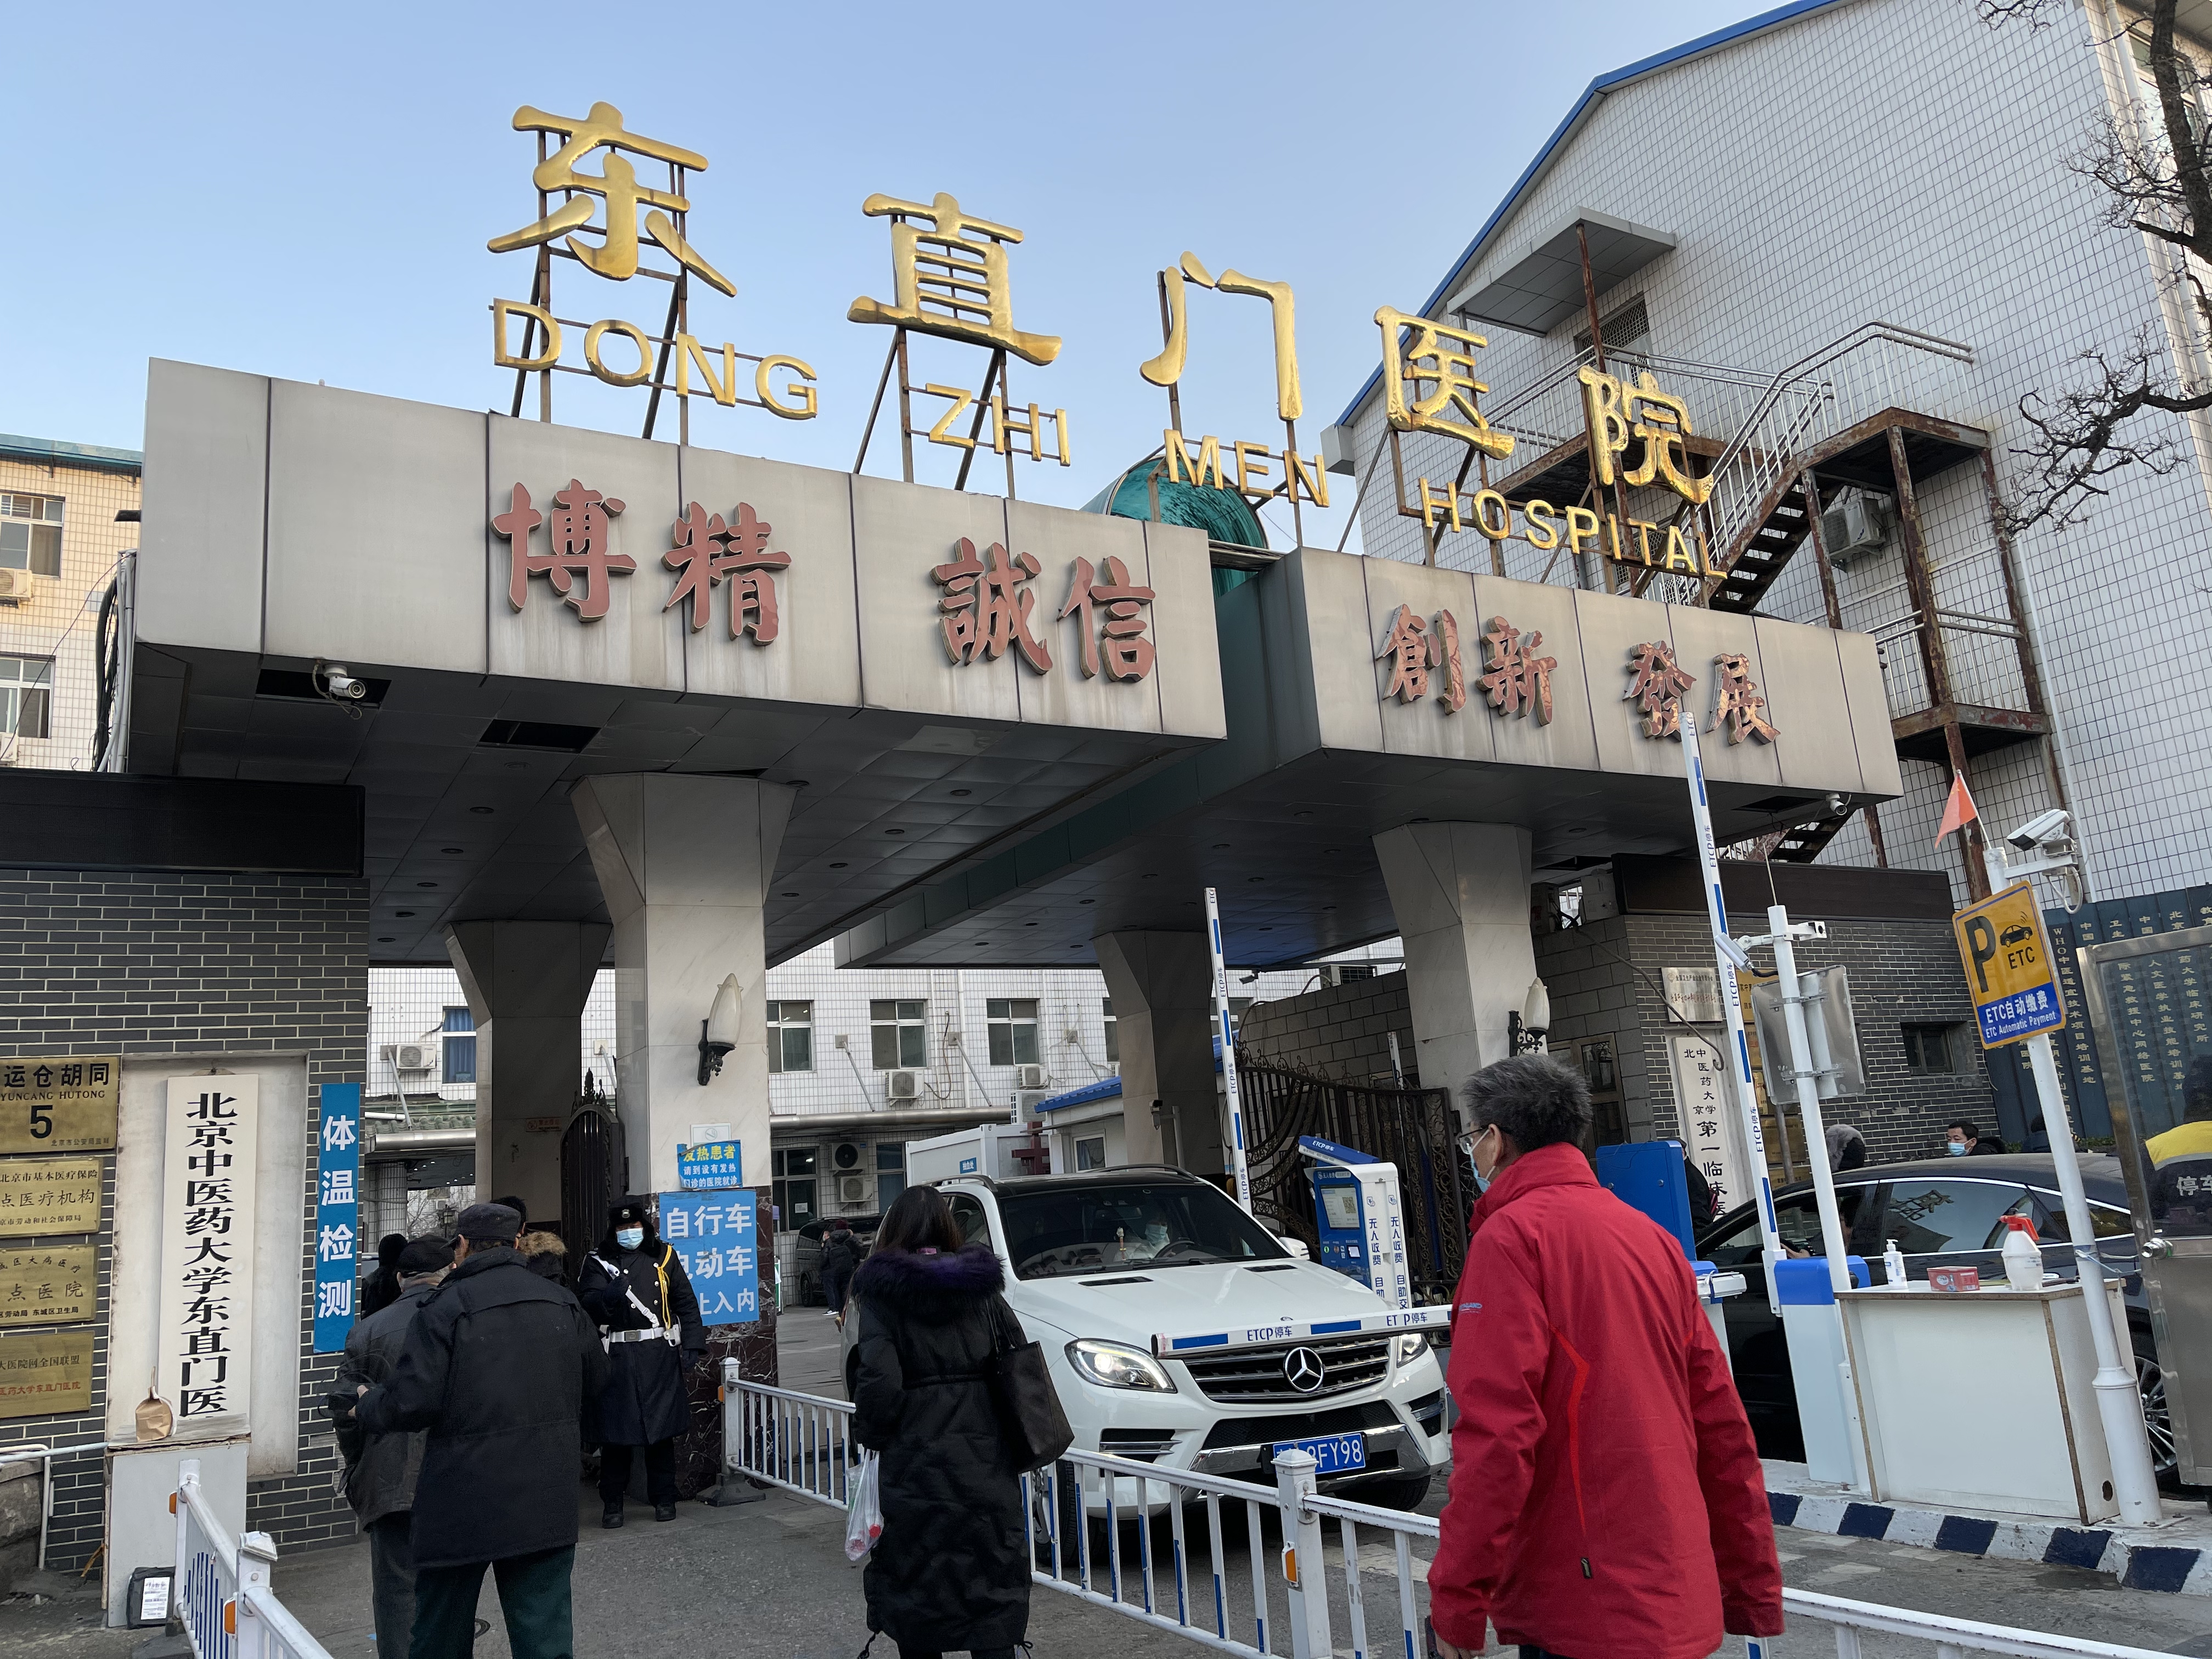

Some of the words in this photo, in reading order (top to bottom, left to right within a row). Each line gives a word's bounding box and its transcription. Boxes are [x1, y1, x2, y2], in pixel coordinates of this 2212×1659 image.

[487, 101, 1713, 504] 东直门医院
[493, 298, 817, 420] DONG
[925, 382, 1070, 466] ZHI
[1164, 428, 1330, 507] MEN
[1418, 477, 1728, 579] HOSPITAL
[492, 478, 792, 646] 博精
[929, 537, 1156, 683] 誠信
[1376, 603, 1558, 726] 創新
[1703, 825, 1717, 868] ETCP停车
[2080, 922, 2094, 947] 中国
[2139, 916, 2153, 934] 中国
[1964, 916, 1996, 993] P
[2007, 946, 2035, 969] ETC
[1726, 962, 1740, 1007] ETCP停车
[2177, 949, 2209, 1043] 药大学临床研究所
[1985, 990, 2049, 1024] ETC自动缴费
[1985, 1026, 1997, 1039] ETC
[1999, 1018, 2028, 1035] Automatic
[2029, 1010, 2057, 1026] Payment
[4, 1063, 109, 1088] 运仓胡同
[1, 1092, 54, 1101] YUNCANG
[59, 1090, 105, 1099] HUTONG
[30, 1104, 53, 1139] 5
[1750, 1105, 1764, 1152] ETCP停车
[0, 1169, 98, 1183] 北京市基本医疗保险
[683, 1162, 736, 1176] 请到设有发热
[684, 1175, 738, 1188] 门诊的医院就诊
[1, 1189, 95, 1207] 点医疗机构
[317, 1114, 356, 1319] 体温检测
[667, 1203, 752, 1239] 自行车
[179, 1092, 238, 1420] 北京中医药大学东直门医
[1368, 1218, 1381, 1266] 无人收费
[1390, 1216, 1403, 1263] 无人收费
[32, 1306, 78, 1316] 东城区卫生局
[1247, 1326, 1293, 1342] ETCP停车
